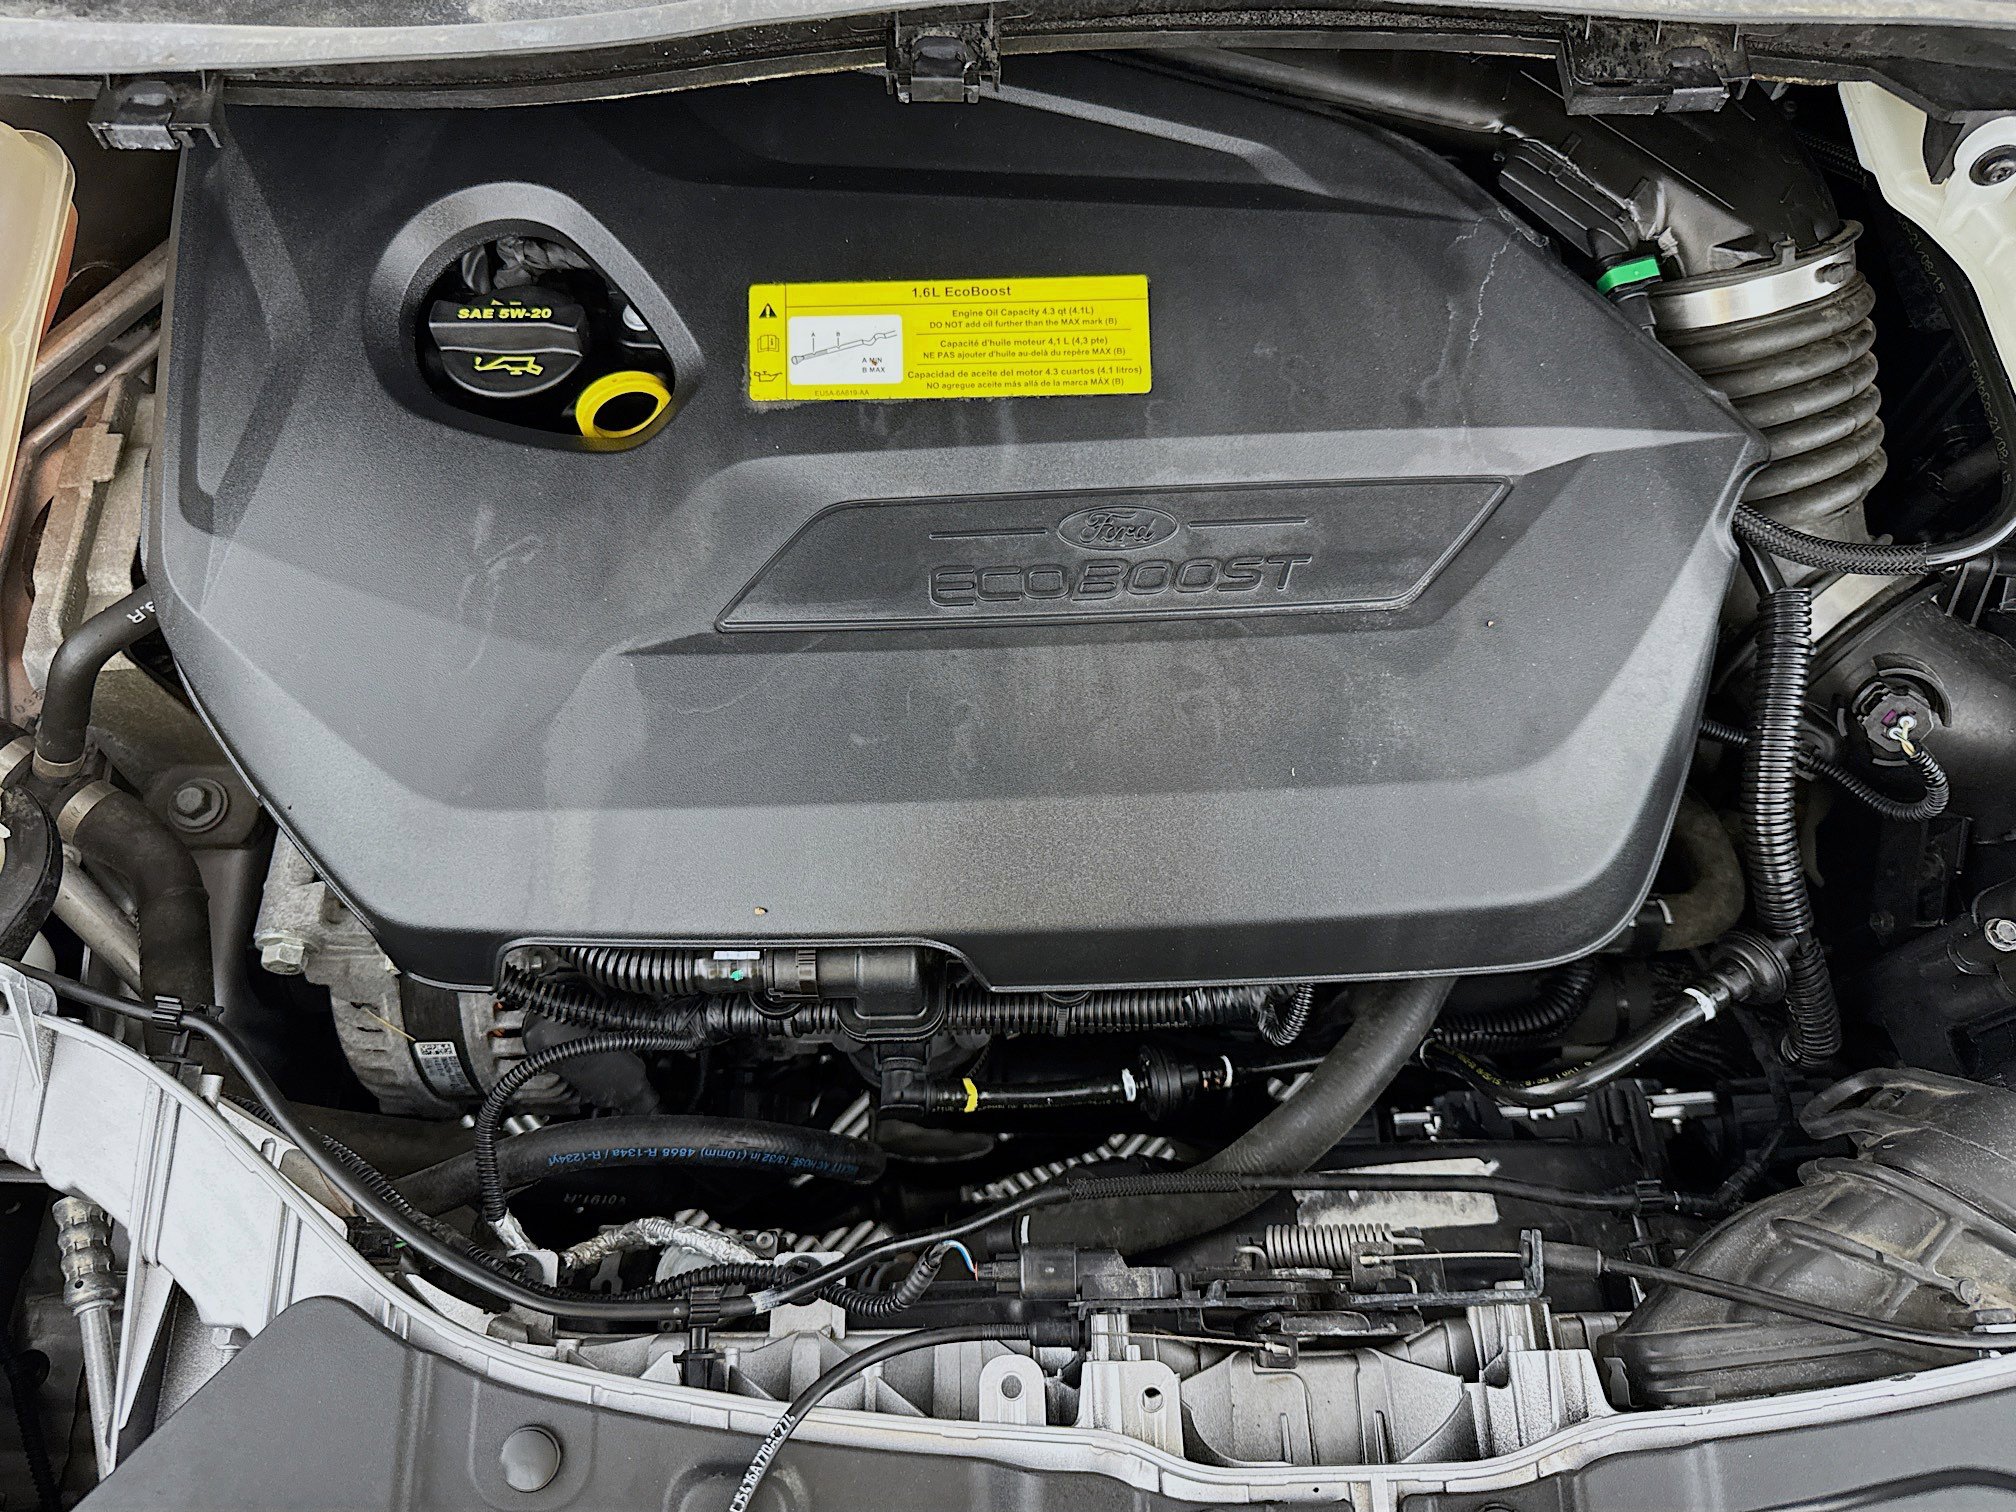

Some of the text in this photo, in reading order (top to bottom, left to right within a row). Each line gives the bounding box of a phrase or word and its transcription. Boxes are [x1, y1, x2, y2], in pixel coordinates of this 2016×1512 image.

[912, 286, 1012, 298] 1.6L EcoBoost
[457, 308, 552, 319] SAE 5W-20
[952, 306, 1094, 319] Engine Oil Capacity 4.3 qt (4.1L)
[930, 321, 942, 329] DO
[945, 321, 963, 329] NOT
[983, 320, 993, 328] oil
[995, 320, 1023, 328] further
[1025, 319, 1044, 327] than
[1046, 319, 1059, 327] the
[1061, 318, 1080, 326] MAX
[1082, 318, 1103, 326] mark
[1105, 317, 1118, 326] (B)
[940, 340, 979, 349] Capacité
[981, 339, 1012, 347] d'huile
[1014, 338, 1045, 347] moteur
[1063, 337, 1070, 345] L
[1091, 336, 1108, 346] pte)
[923, 352, 935, 360] NE
[957, 351, 986, 360] ajouter
[988, 350, 1016, 358] d'huile
[1050, 349, 1062, 357] du
[1092, 348, 1111, 356] MAX
[1113, 347, 1126, 356] (B)
[907, 366, 1143, 380] Capacidad de aceite del motor 4.3 cuartos (4.1 litros)
[926, 382, 940, 390] NO
[941, 383, 976, 391] agregue
[977, 381, 1003, 389] aceite
[1041, 380, 1051, 388] de
[1053, 379, 1061, 387] la
[1062, 380, 1088, 388] marca
[1112, 377, 1124, 386] (B)
[1079, 510, 1156, 544] Ford
[547, 1149, 602, 1168] R-1234yf
[611, 1147, 658, 1159] R-134a
[662, 1147, 697, 1158] 4868
[700, 1147, 748, 1162] (10mm)
[761, 1152, 790, 1166] 13/32
